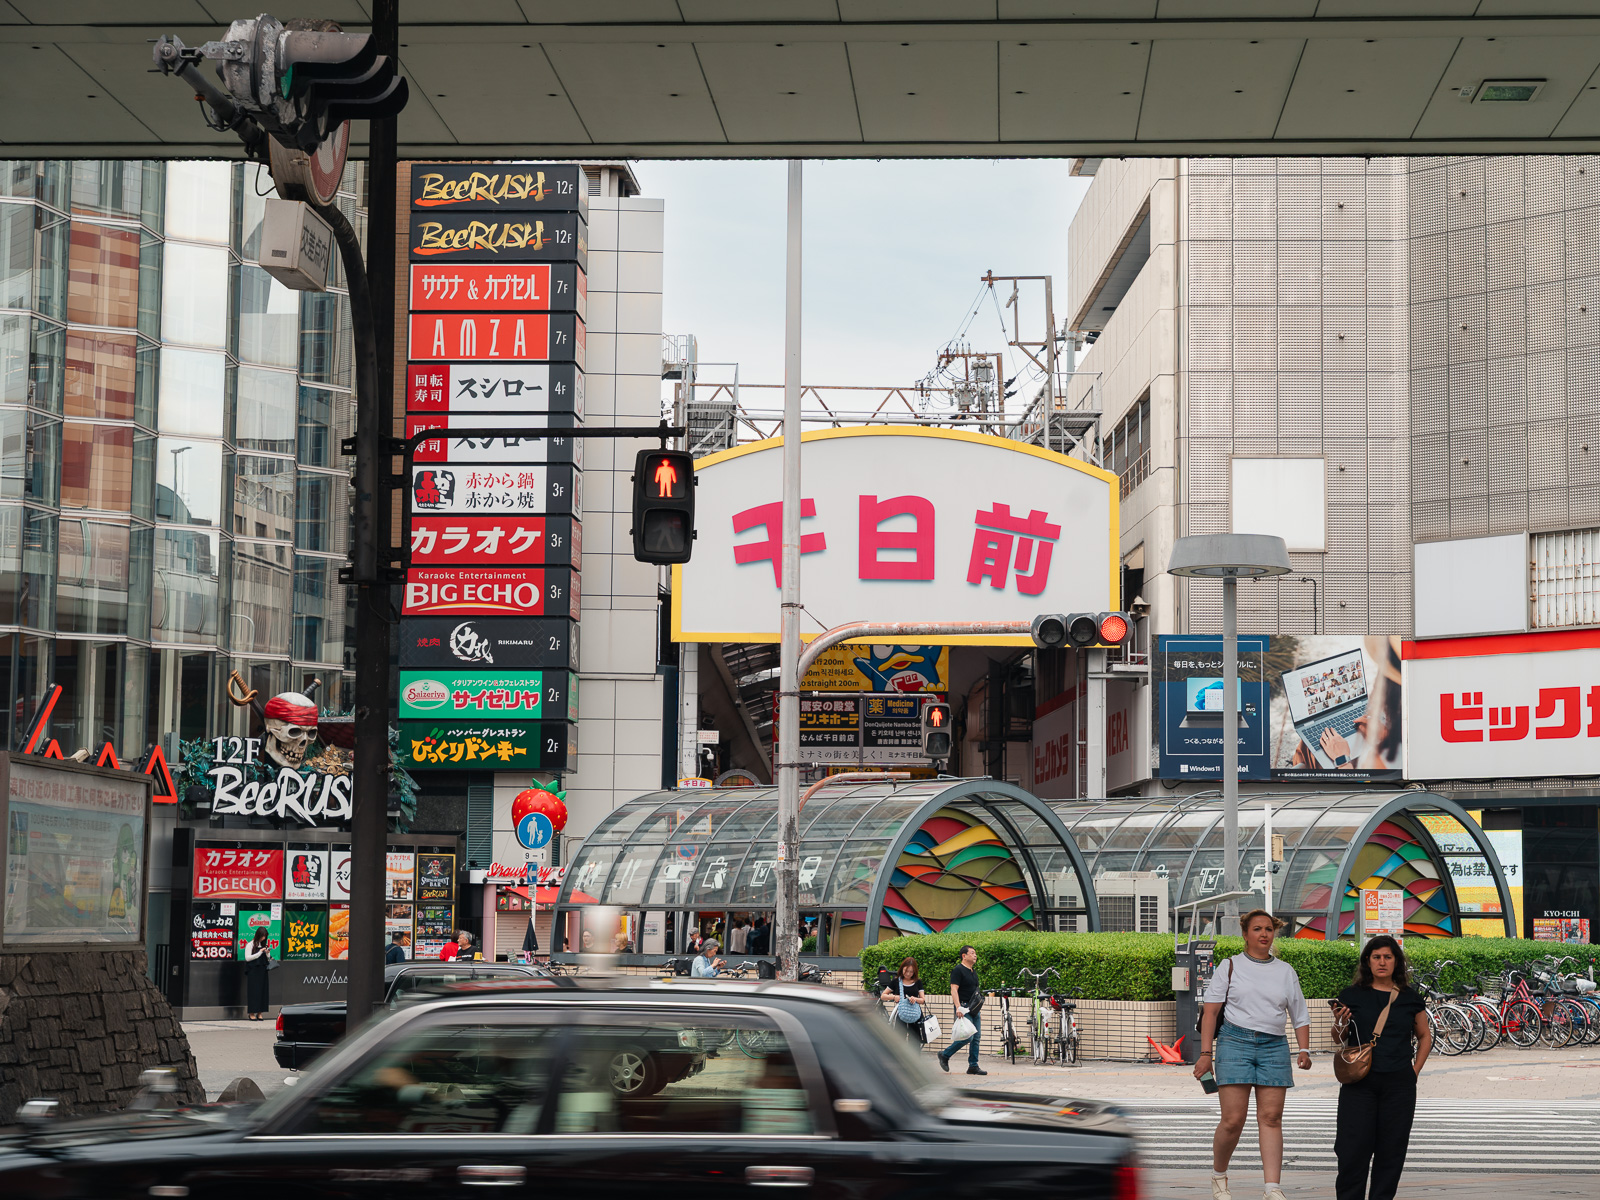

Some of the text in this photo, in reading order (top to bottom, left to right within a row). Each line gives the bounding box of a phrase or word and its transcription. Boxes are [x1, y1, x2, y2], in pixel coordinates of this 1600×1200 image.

[556, 181, 573, 194] 12F
[555, 230, 572, 243] 12F
[300, 224, 328, 271] 交差点内
[421, 274, 540, 300] サウナ & カプセル
[557, 281, 568, 294] 7F
[432, 319, 527, 356] AMZA
[555, 331, 567, 344] 7F
[415, 374, 444, 387] 回転
[414, 389, 442, 403] 寿司
[455, 378, 543, 399] スシロー
[555, 382, 566, 395] 4F
[465, 472, 564, 497] 赤から鍋 3F
[465, 492, 534, 509] 赤から焼
[411, 527, 541, 555] カラオケ
[551, 534, 562, 547] 3F
[732, 495, 1061, 596] 千日前
[418, 572, 526, 580] Karaoke Entertainment
[406, 582, 457, 608] BIG
[463, 582, 540, 607] ECHO
[550, 585, 562, 599] 3F
[417, 638, 441, 647] 焼肉
[550, 637, 561, 650] 2F
[451, 679, 541, 687] イタリアンワイン&カフェレストラン
[807, 680, 837, 688] straight
[407, 688, 446, 702] Saizeriya
[452, 689, 541, 710] サイゼリヤ
[548, 688, 560, 702] 2F
[801, 701, 855, 711] 驚安の殿堂
[868, 698, 884, 713] 薬
[447, 729, 527, 738] ハンバーグレストラン
[801, 734, 855, 742] なんば千日前店
[211, 736, 262, 765] 12F
[411, 737, 559, 763] びっくりドンキー 2F
[683, 780, 706, 788] 千日前
[207, 766, 353, 827] BeeRUS
[205, 850, 271, 867] カラオケ
[1447, 862, 1518, 877] 為は禁です
[199, 876, 276, 894] BIG ECHO
[290, 922, 319, 938] びっくり
[287, 937, 321, 953] ドンキー
